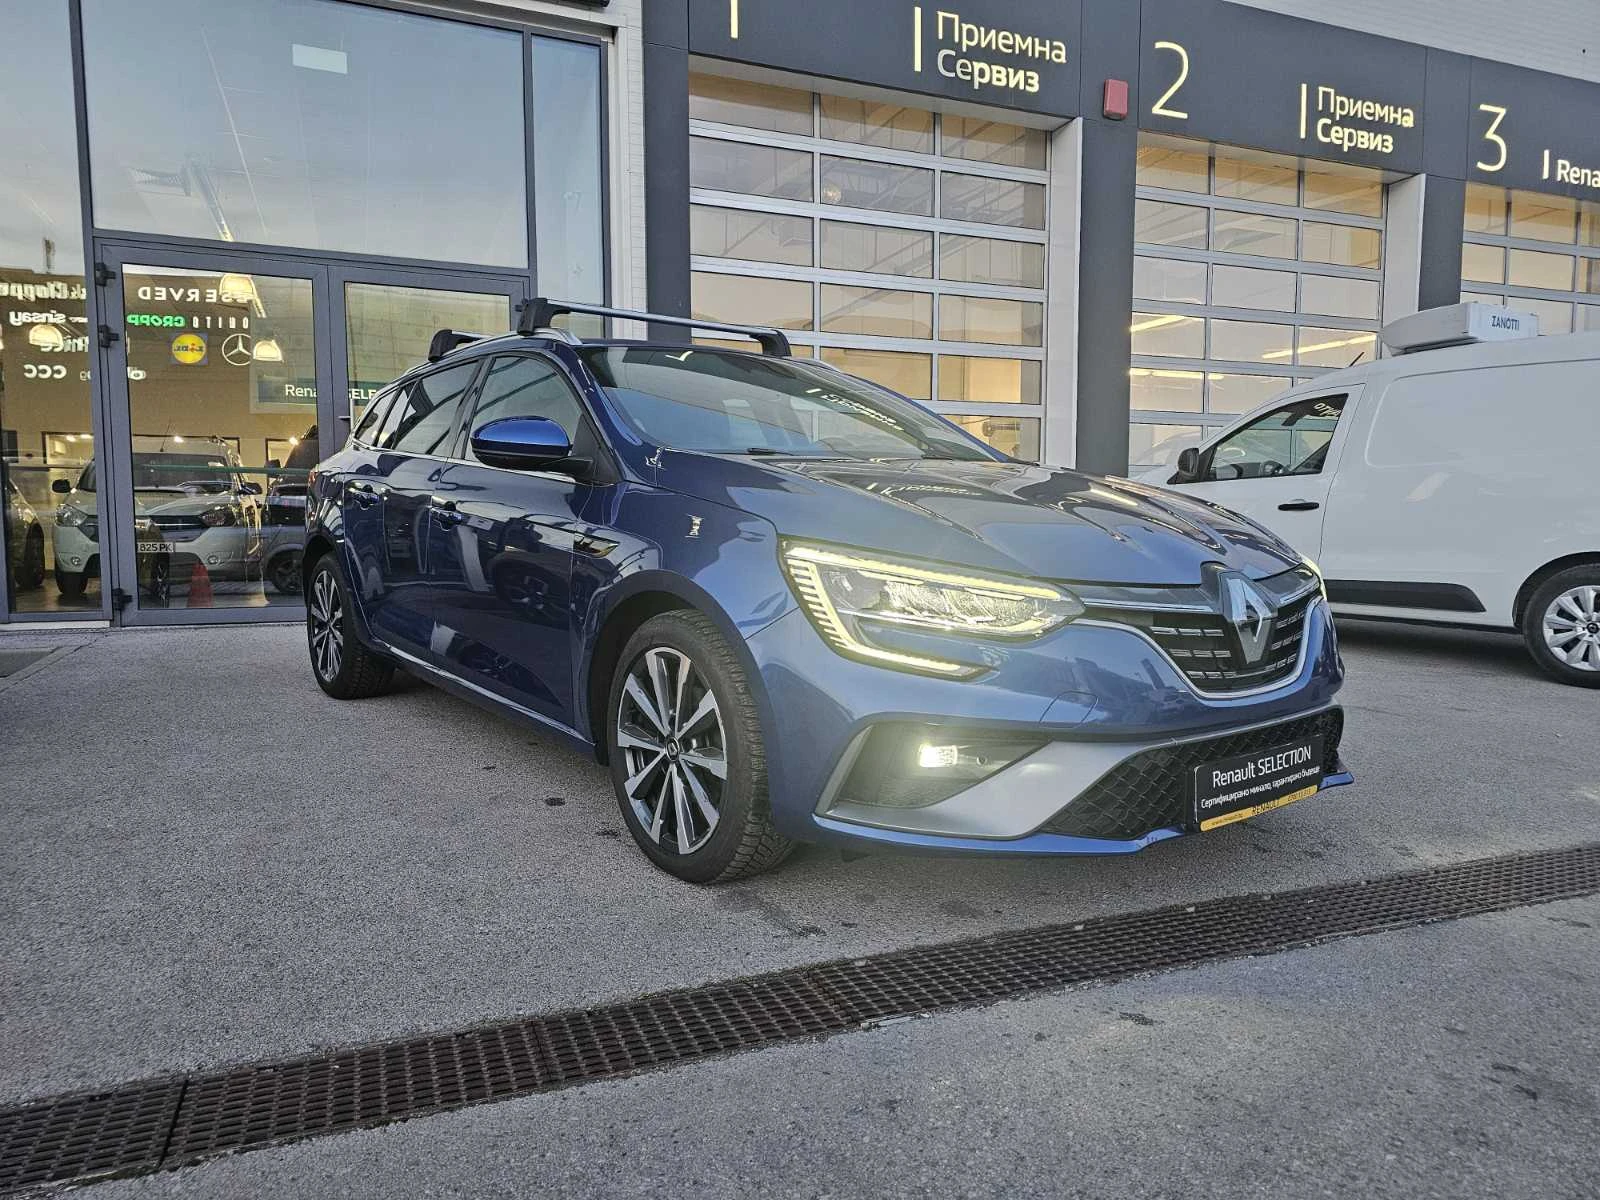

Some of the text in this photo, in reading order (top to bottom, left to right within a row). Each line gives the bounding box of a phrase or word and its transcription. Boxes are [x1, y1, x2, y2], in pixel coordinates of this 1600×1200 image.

[937, 11, 1067, 63] Приемна
[937, 49, 1040, 93] Сервиз
[1152, 41, 1190, 119] 2
[1318, 86, 1415, 128] Приемна
[1316, 117, 1394, 154] Сервиз
[1476, 103, 1508, 172] 3
[1491, 315, 1520, 331] ZANOTTI
[1212, 744, 1312, 788] Renault SELECTION
